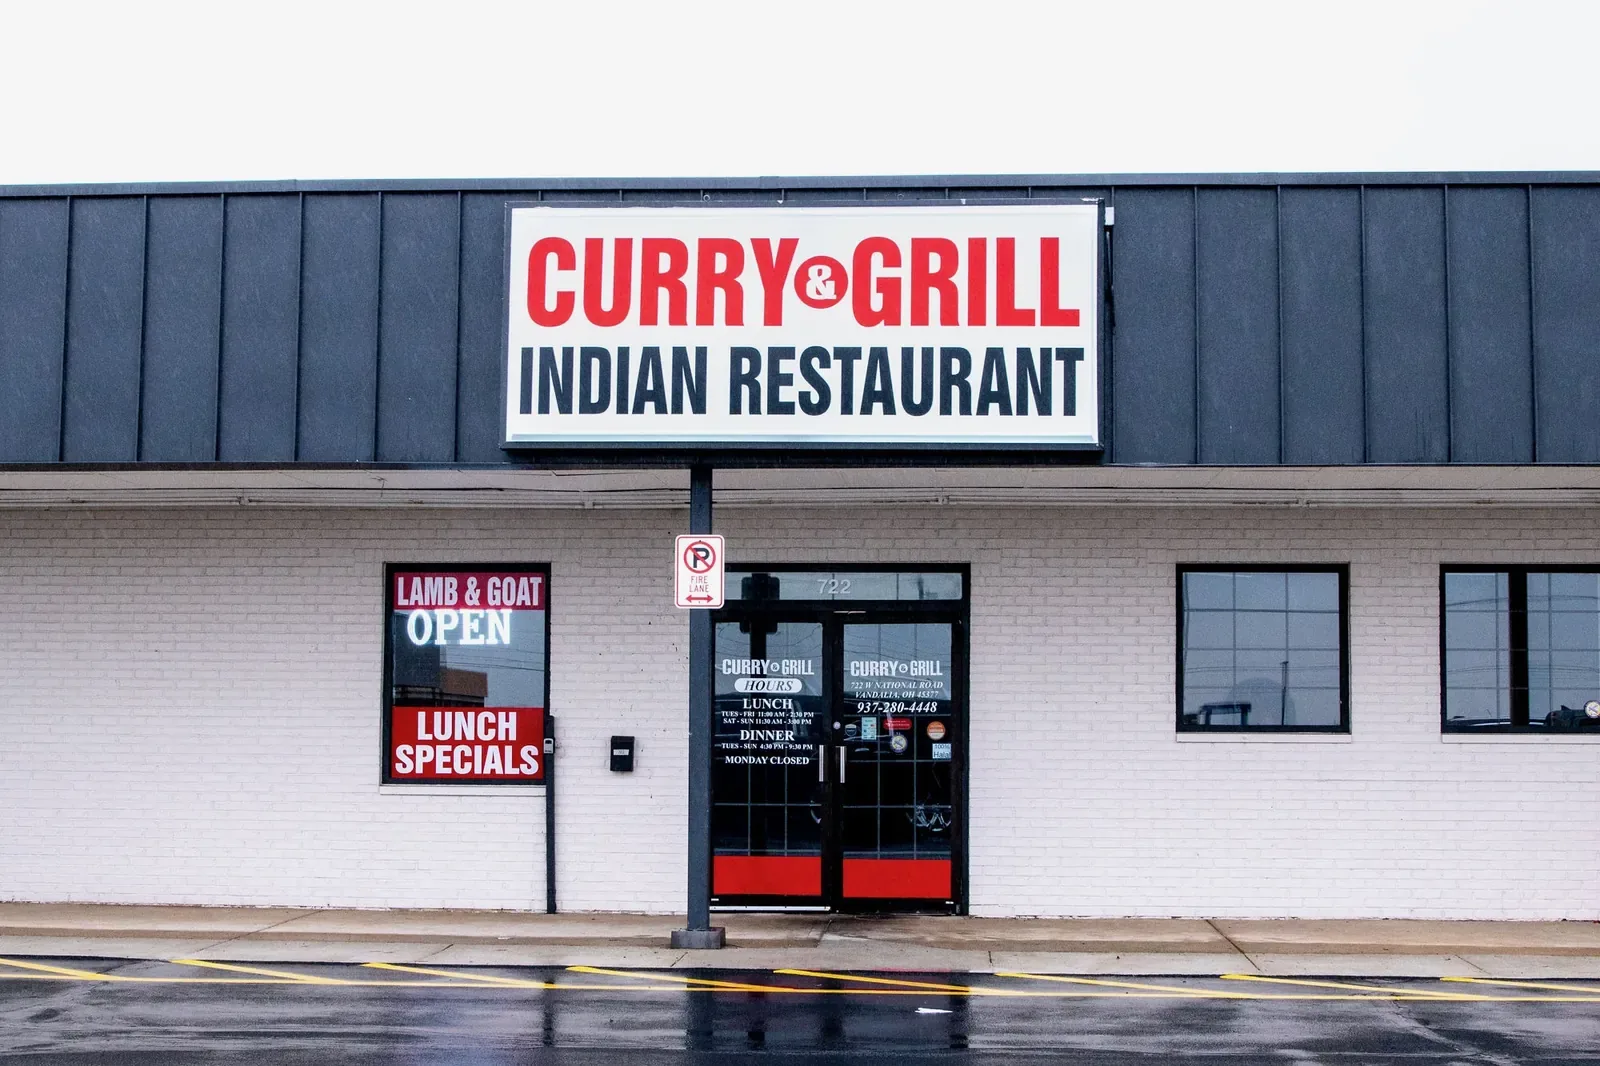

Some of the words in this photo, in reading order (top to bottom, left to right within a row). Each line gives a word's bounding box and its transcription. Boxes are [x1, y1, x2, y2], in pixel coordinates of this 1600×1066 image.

[527, 236, 799, 327] CURRY
[806, 264, 836, 300] &
[852, 236, 1081, 327] GRILL
[519, 346, 707, 415] INDIAN
[729, 345, 1085, 417] RESTAURANT
[690, 575, 708, 584] FIRE
[397, 576, 458, 606] LAMB
[465, 576, 481, 606] &
[488, 576, 542, 606] GOAT
[689, 584, 710, 592] LANE
[817, 579, 851, 594] 722
[407, 608, 513, 646] OPEN
[722, 659, 770, 675] CURRY
[782, 659, 815, 675] GRILL
[850, 660, 898, 676] CURRY
[910, 660, 943, 676] GRILL
[744, 680, 793, 691] HOURS
[874, 681, 918, 689] NATIONAL
[919, 681, 943, 689] ROAD
[855, 691, 900, 699] VANDALIA,
[917, 690, 939, 698] 45377
[743, 698, 793, 709] LUNCH
[857, 701, 938, 713] 937-280-4448
[417, 711, 517, 741] LUNCH
[740, 729, 795, 741] DINNER
[395, 744, 539, 775] SPECIALS
[725, 756, 768, 764] MONDAY
[770, 756, 810, 765] CLOSED
